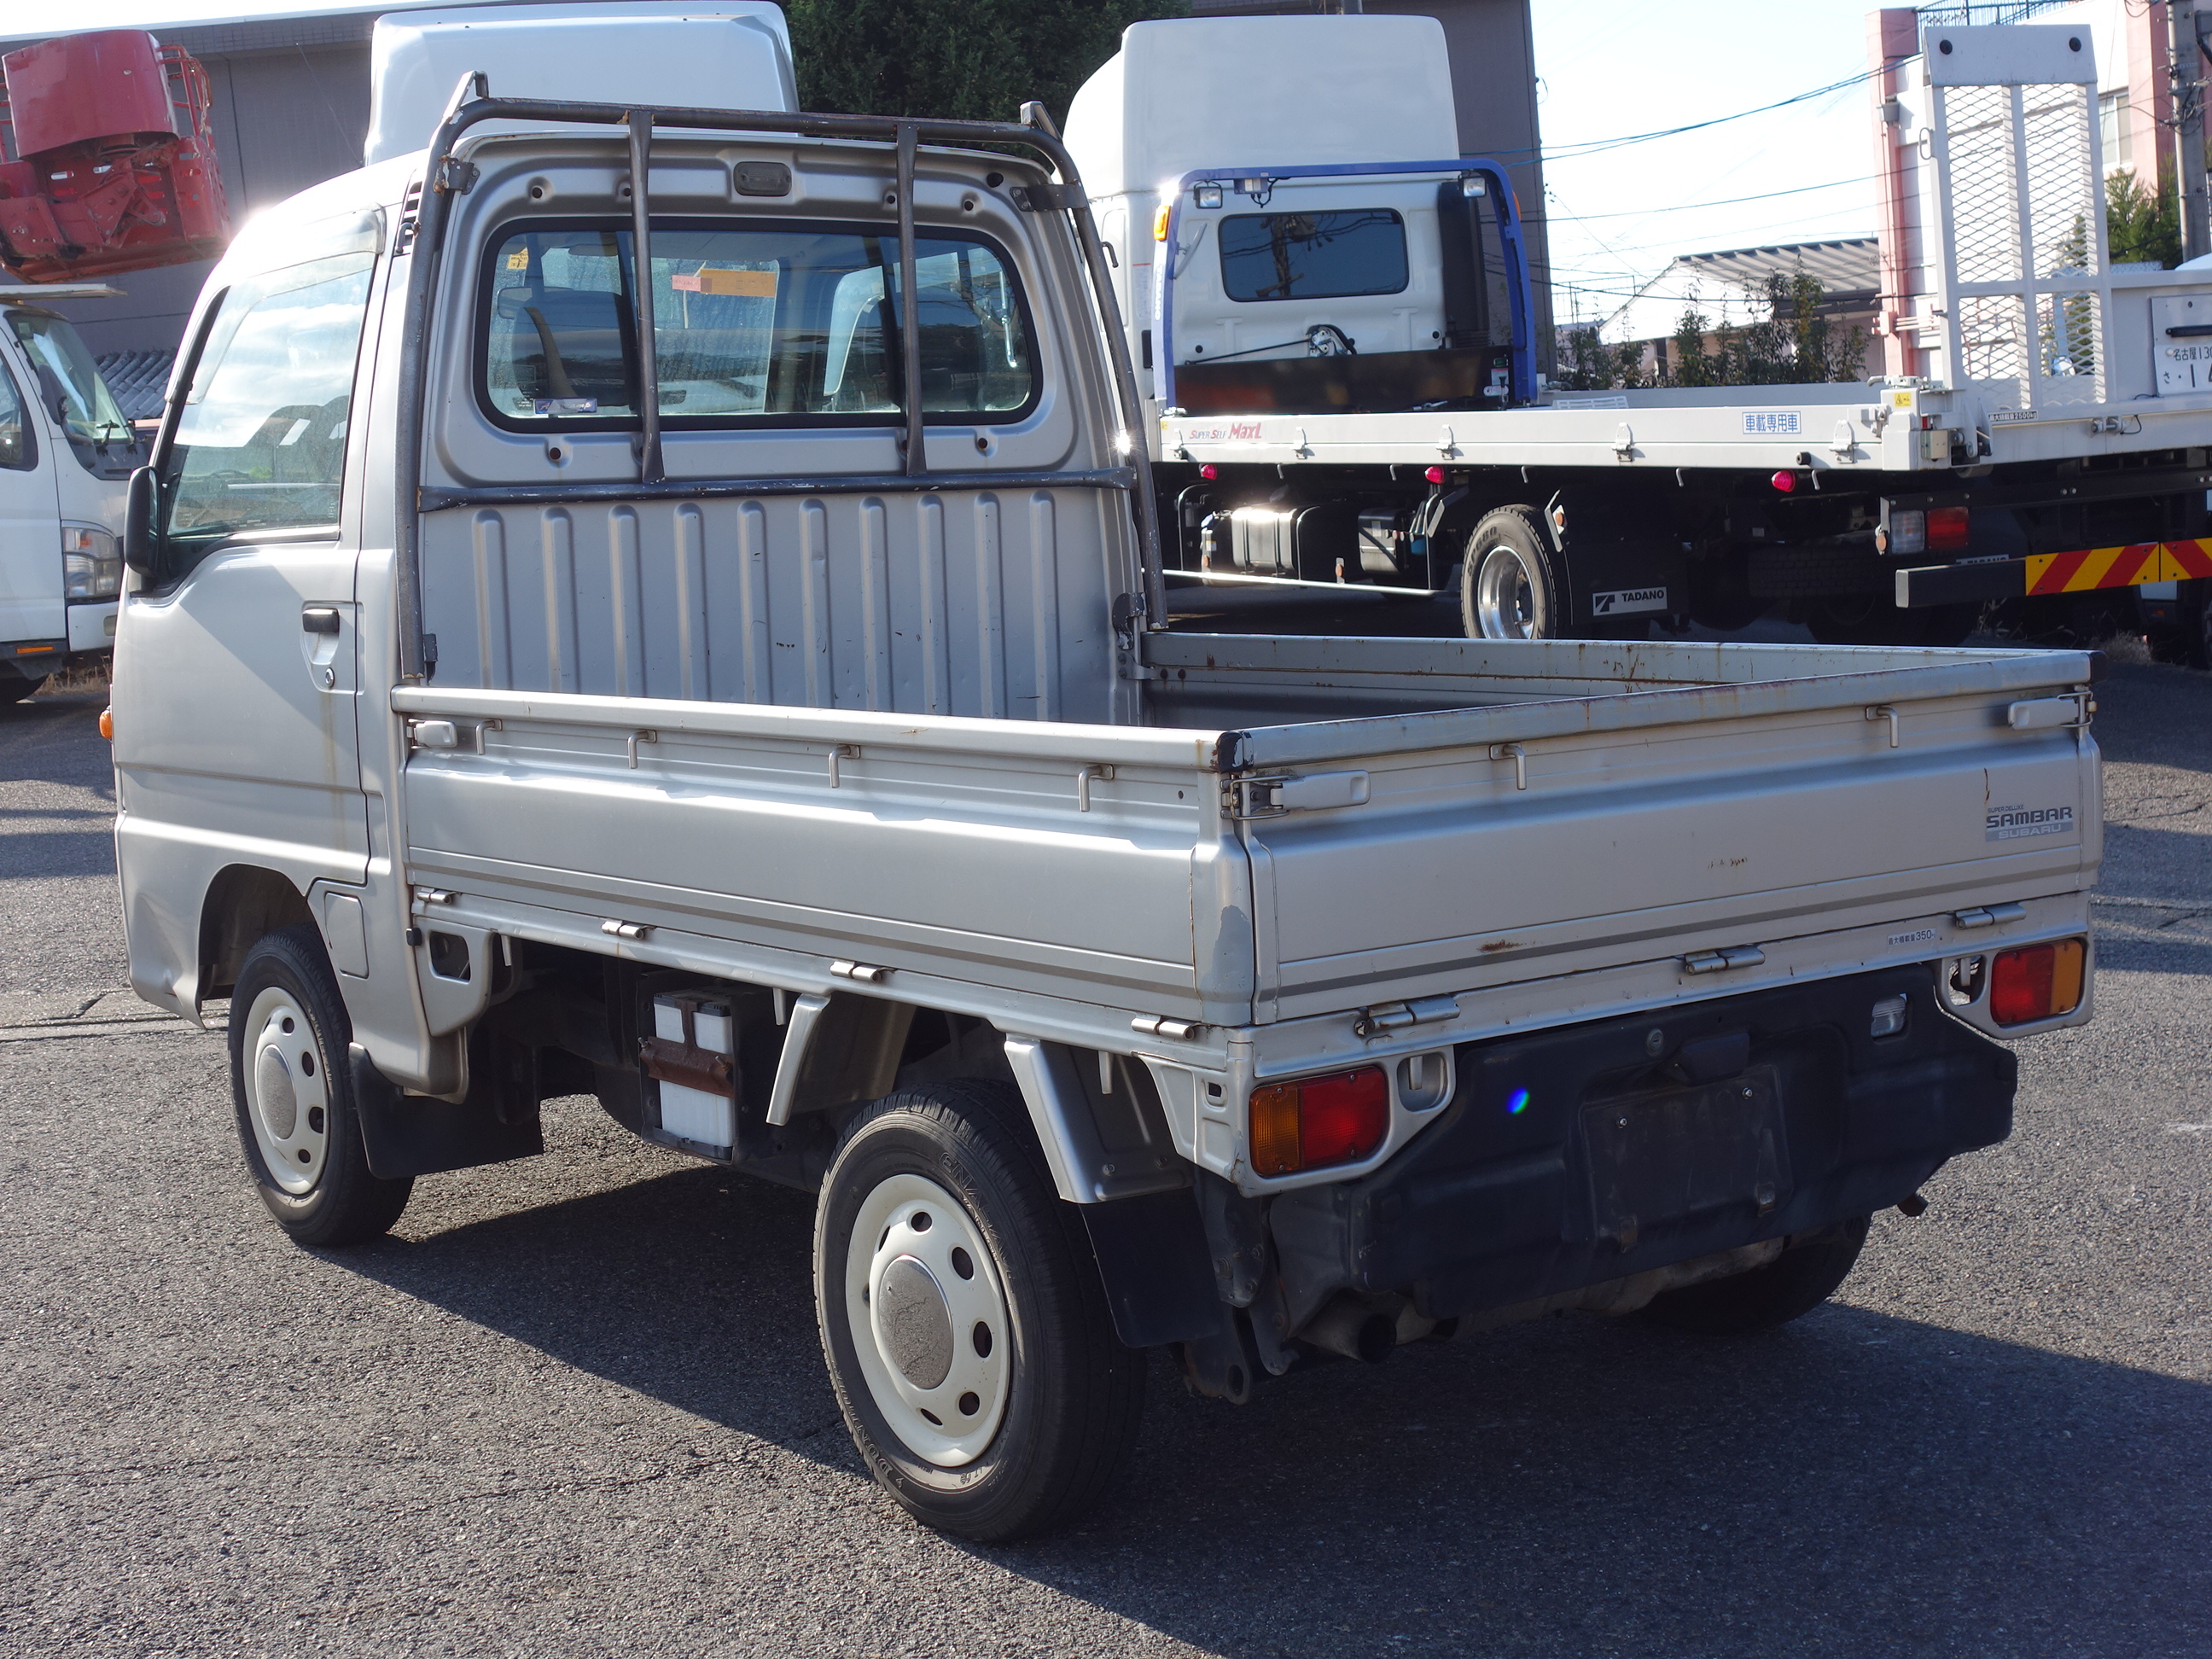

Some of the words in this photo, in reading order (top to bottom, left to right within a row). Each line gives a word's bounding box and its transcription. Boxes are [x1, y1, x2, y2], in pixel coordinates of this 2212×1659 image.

[1745, 414, 1798, 432] 車載専用車
[1190, 430, 1210, 439] SUPER
[1210, 429, 1226, 439] SELF
[1621, 590, 1664, 602] TADANO
[1987, 806, 2072, 828] SAMBAR
[1999, 824, 2062, 839] SUBARU
